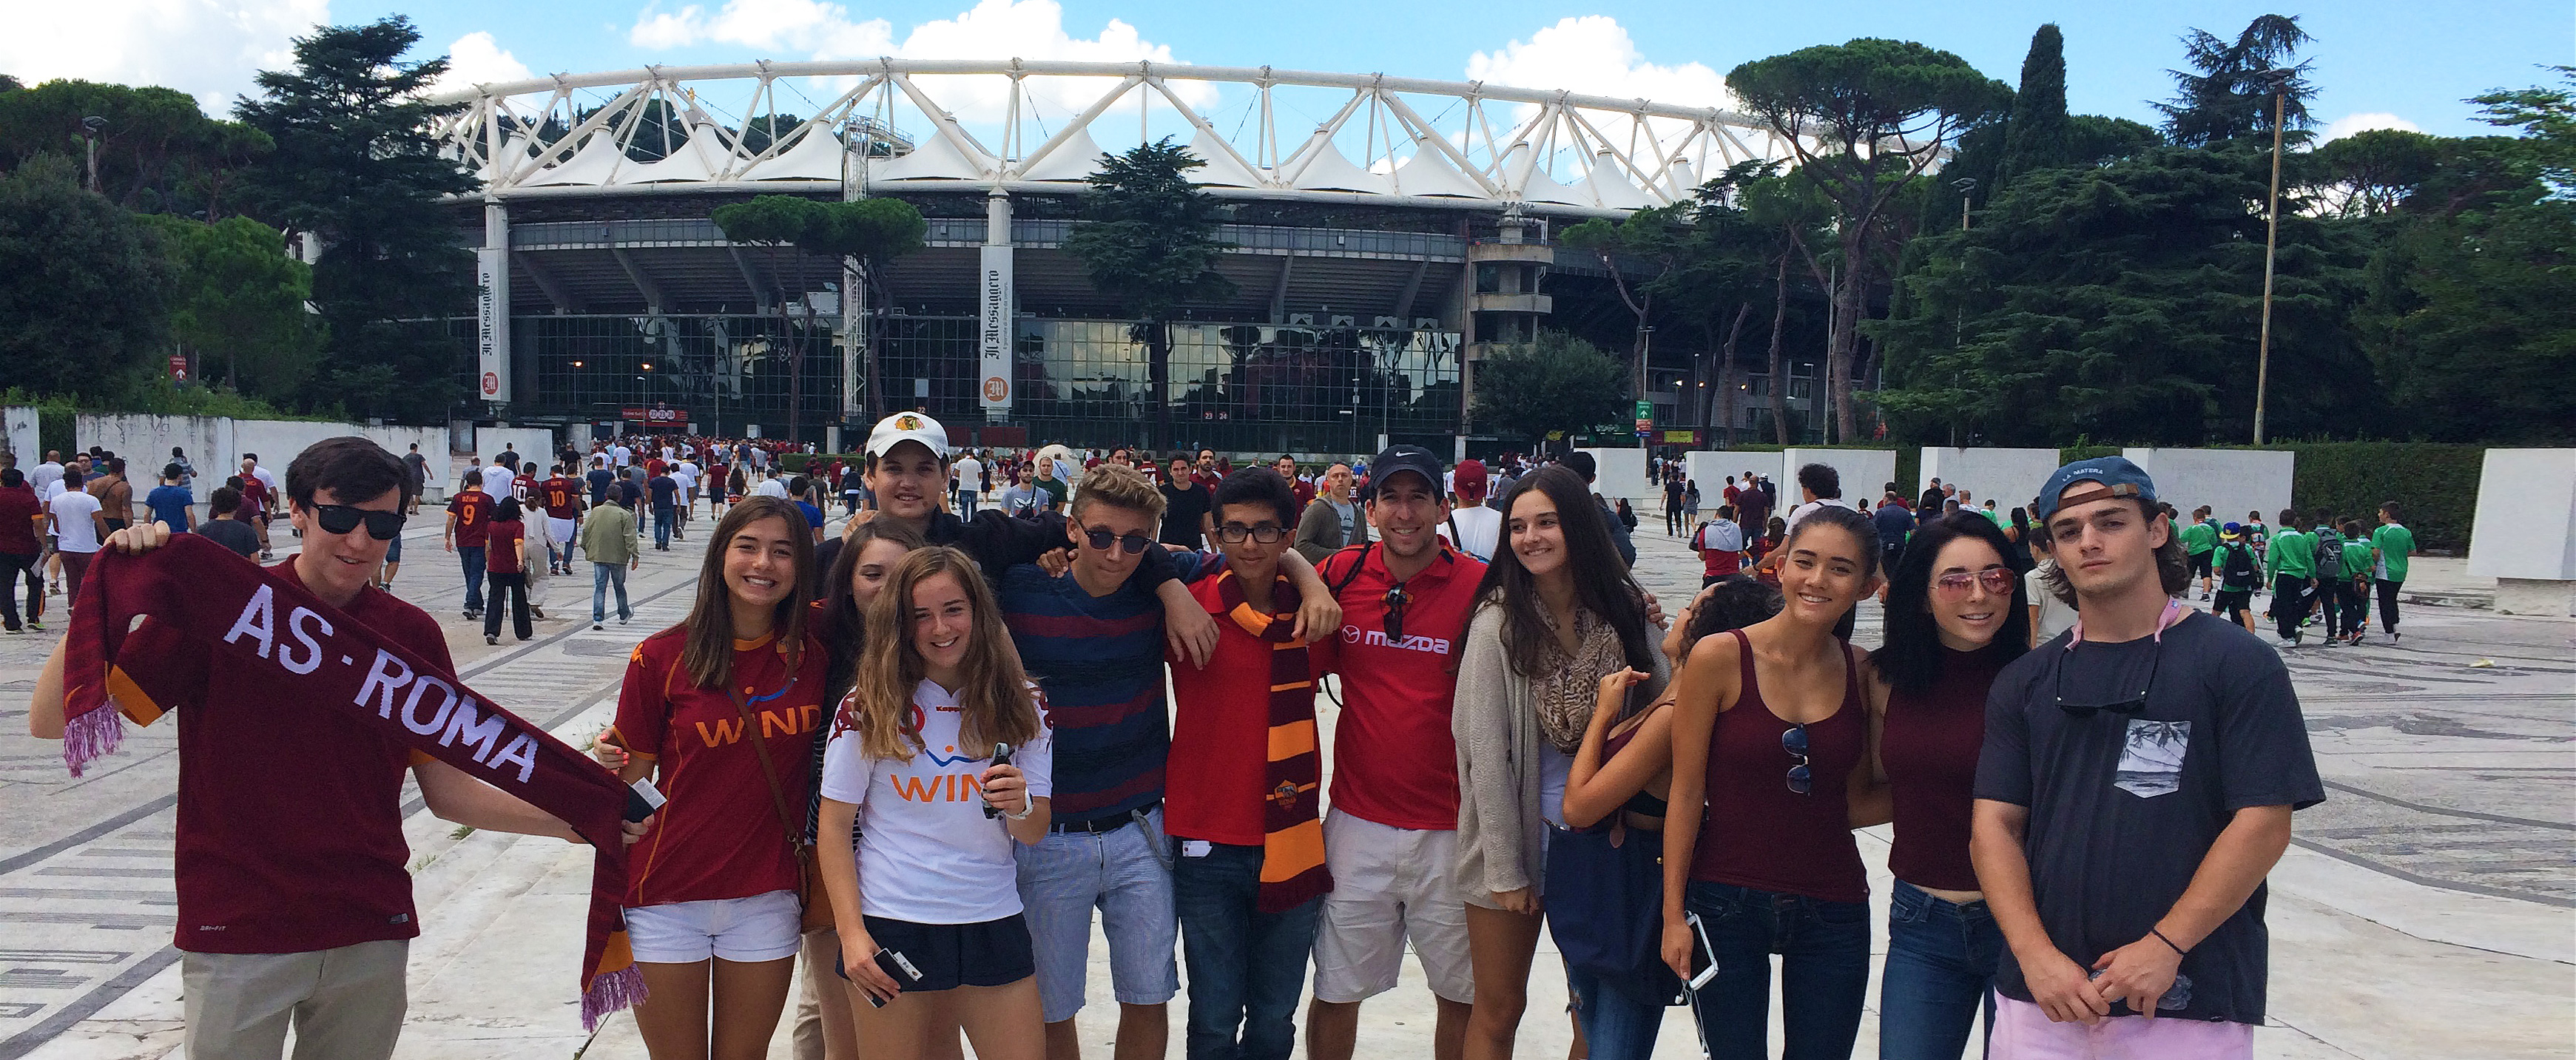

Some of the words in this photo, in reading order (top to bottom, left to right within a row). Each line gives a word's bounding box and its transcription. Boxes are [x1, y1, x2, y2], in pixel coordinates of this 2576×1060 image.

[985, 270, 1002, 343] Messaggero
[988, 380, 1004, 397] M
[2062, 474, 2071, 482] LA
[513, 485, 527, 502] 10
[550, 490, 565, 507] 10
[462, 504, 476, 525] 9
[354, 648, 539, 783] ROMA
[695, 705, 822, 748] WND
[890, 774, 982, 802] WIN
